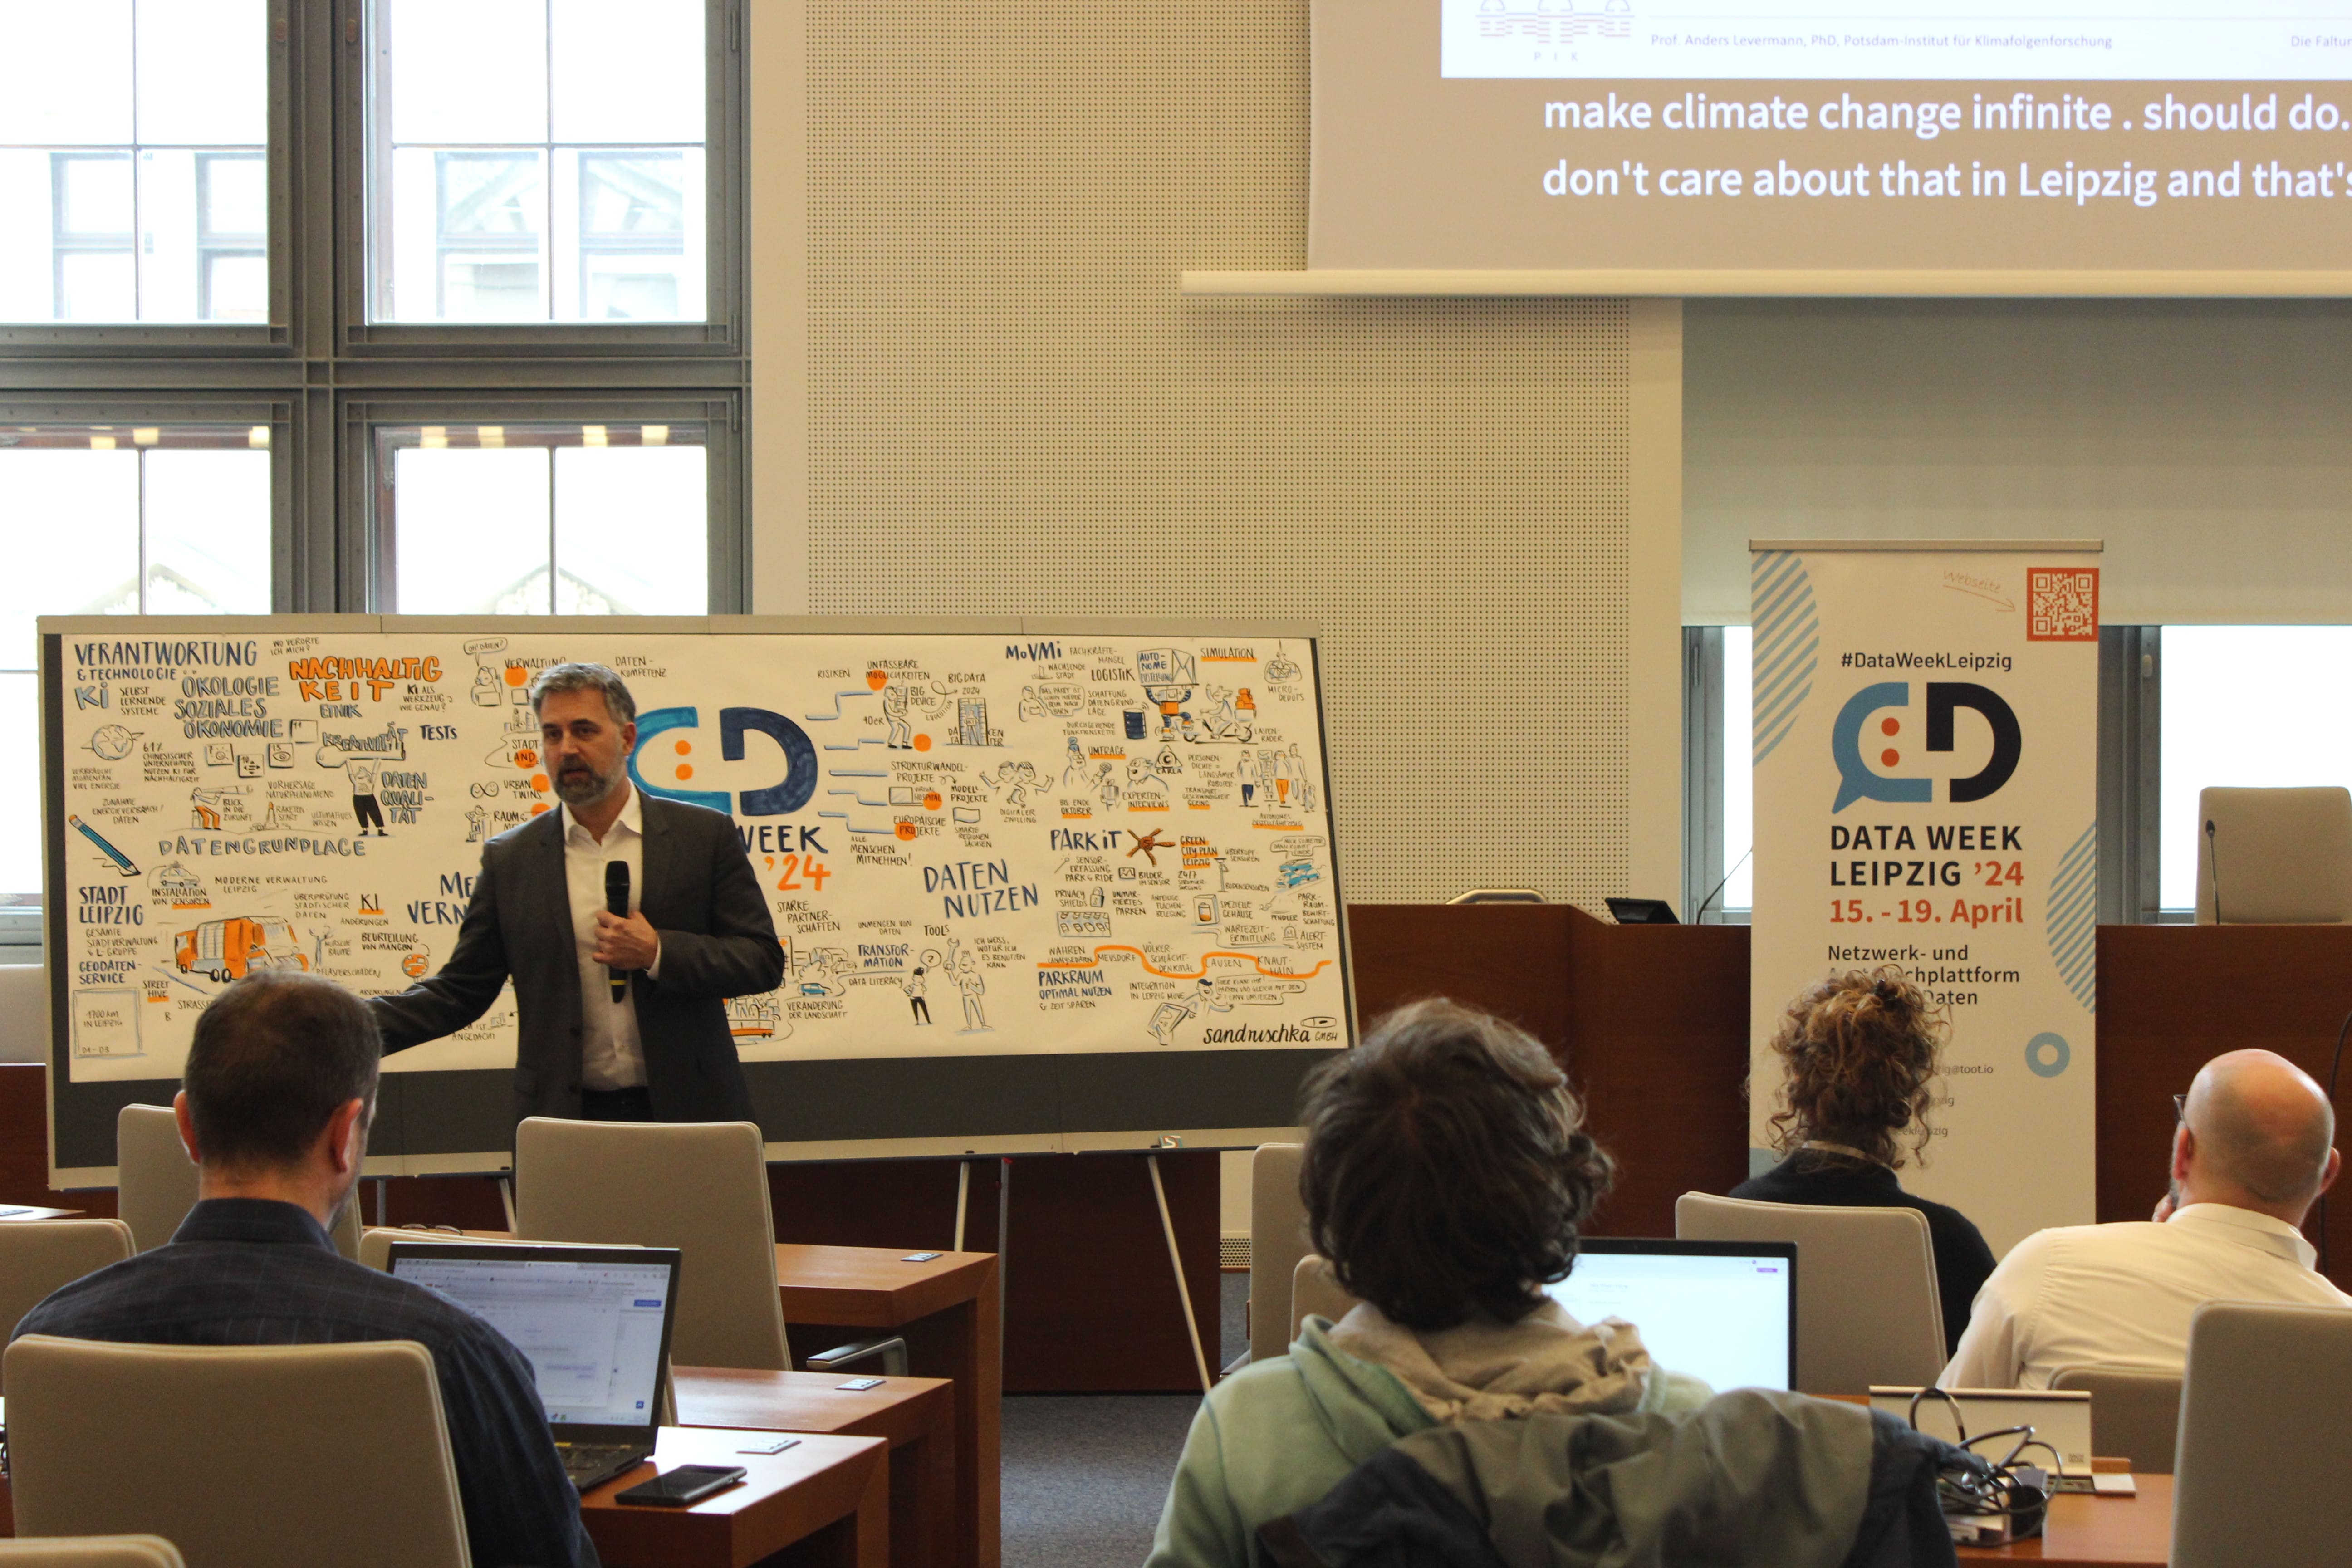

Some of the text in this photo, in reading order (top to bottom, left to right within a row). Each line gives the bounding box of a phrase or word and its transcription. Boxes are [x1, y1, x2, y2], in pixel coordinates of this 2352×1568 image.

[1651, 34, 2112, 49] Prof. Anders Levermann, PhD, Potsdam-Institut für Klimafolgenforschung
[2291, 35, 2312, 46] Die
[1544, 92, 1651, 129] make
[1663, 92, 1808, 129] climate
[1819, 93, 1961, 139] change
[1973, 93, 2112, 130] infinite
[2143, 93, 2277, 130] should
[2288, 94, 2351, 130] do.
[1543, 160, 1649, 196] don't
[1659, 167, 1742, 196] care
[1754, 160, 1869, 196] about
[1880, 161, 1960, 196] that
[1972, 162, 2006, 196] in
[2020, 162, 2157, 206] Leipzig
[2167, 161, 2240, 196] and
[1943, 569, 2001, 594] Webseite
[286, 637, 319, 645] VERORTE
[75, 641, 257, 666] VERANTWORTUNG
[1200, 647, 1254, 659] SIMULATION
[867, 660, 918, 669] UNFASSBARE
[1842, 652, 2012, 672] #DataWeekLeipzig
[289, 656, 442, 681] NACHHALTIG
[620, 667, 667, 678] KOMPETENZ
[818, 669, 850, 678] RISIKEN
[90, 667, 176, 681] TECHNOLOGIE
[965, 673, 986, 683] DATA
[1091, 668, 1136, 681] LOGISTIK
[182, 669, 280, 698] ÖKOLOGIE
[120, 686, 151, 696] SELBST
[300, 680, 394, 702] KEIT
[910, 686, 925, 696] BIG
[962, 686, 980, 695] 2024
[121, 696, 167, 706] LERNENDE
[403, 694, 444, 703] WERKZEUG
[911, 696, 936, 706] DEVICE
[121, 707, 159, 715] SYSTEME
[174, 698, 267, 720] SOZIALES
[320, 703, 362, 718] ETHIK
[143, 751, 193, 761] CHINESISCHER
[381, 771, 427, 789] DATEN
[897, 773, 934, 784] PROJEKTE
[268, 780, 316, 789] VORHERSAGE
[504, 779, 531, 789] URBAN
[951, 793, 988, 803] PROJEKTE
[1061, 807, 1093, 816] OKTOBER
[113, 816, 139, 824] DATEN
[494, 812, 519, 822] RAUM
[900, 826, 940, 838] PROJEKTE
[1180, 836, 1206, 845] GREEN
[1831, 825, 2022, 850] DATA WEEK
[159, 835, 366, 857] DATENGRUNDLAGE
[850, 844, 895, 854] MENSCHEN
[1200, 846, 1217, 855] PLAN
[1183, 857, 1210, 866] LEIPZIG
[1070, 864, 1111, 873] ERFASSUNG
[923, 858, 1009, 893] DATEN
[1066, 873, 1114, 882] PARK RIDE
[1831, 861, 1961, 887] LEIPZIG
[215, 875, 328, 885] MODERNE VERWALTUNG
[152, 887, 206, 897] INSTALLATION
[224, 885, 257, 893] LEIPZIG
[1055, 889, 1085, 898] PRIVACY
[79, 885, 129, 905] STADT
[171, 897, 210, 905] SENSOREN
[361, 893, 379, 911] KI
[944, 883, 1039, 919] NUTZEN
[778, 900, 809, 913] STARKE
[1116, 907, 1147, 916] PARKEN
[79, 904, 143, 926] LEIPZIG
[1830, 899, 1873, 923] 15.
[1897, 899, 1942, 923] 19.
[1950, 897, 2024, 929] April
[797, 921, 841, 934] SCHAFTEN
[858, 920, 897, 929] UNMENGEN
[87, 936, 158, 947] STADTVERWALTUNG
[362, 932, 419, 943] BEURTEILUNG
[1230, 933, 1276, 943] ERMITTLUNG
[1828, 945, 1969, 961] Netzwerk- und
[863, 957, 903, 968] MATION
[1159, 964, 1195, 973] DENKMAL
[79, 973, 126, 984] SERVICE
[849, 976, 903, 989] DATA LITERACY
[1039, 969, 1104, 987] PARKRAUM
[143, 981, 169, 990] STREET
[1130, 981, 1176, 990] INTEGRATION
[148, 989, 168, 998] HIVE
[1082, 987, 1112, 997] NUTZEN
[1068, 1000, 1096, 1009] SPAREN
